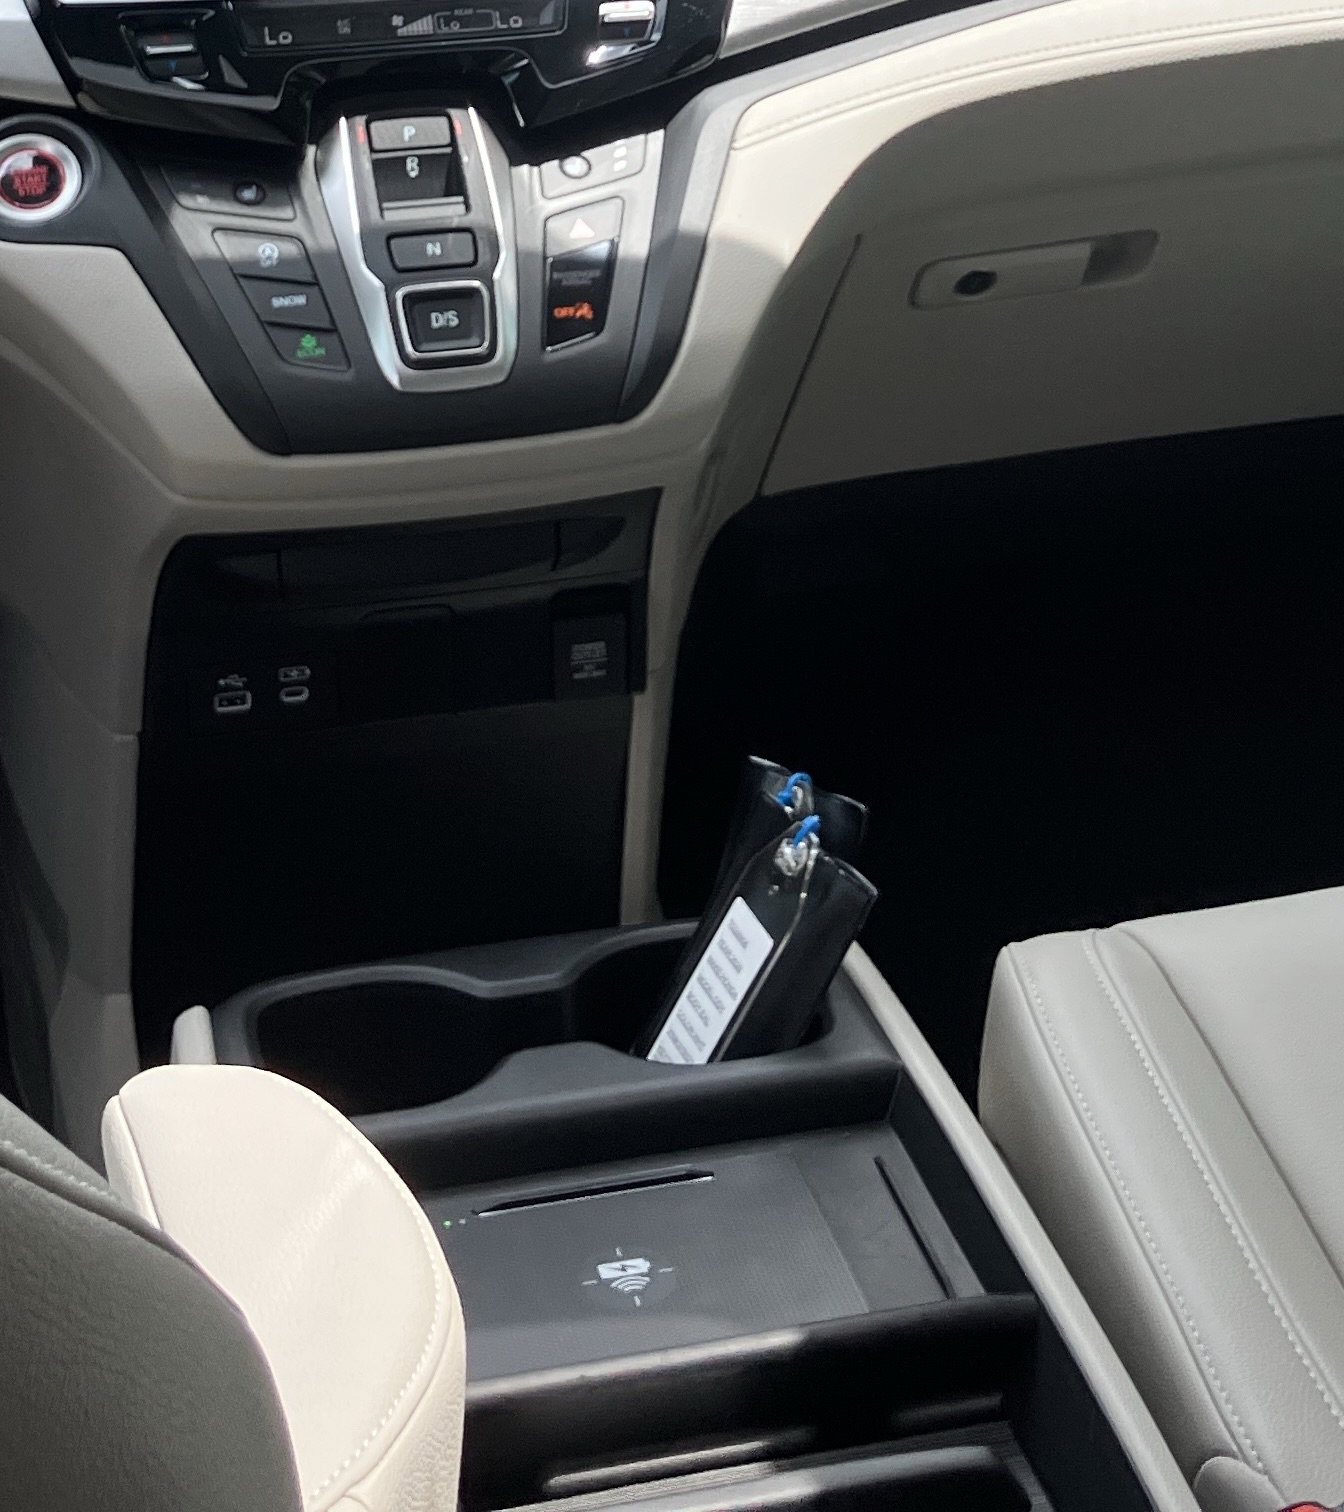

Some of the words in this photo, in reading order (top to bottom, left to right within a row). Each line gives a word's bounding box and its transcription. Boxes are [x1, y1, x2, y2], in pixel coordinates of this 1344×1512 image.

[403, 125, 417, 142] P
[425, 242, 442, 257] N
[271, 293, 308, 309] SNOW
[430, 310, 460, 329] D/S
